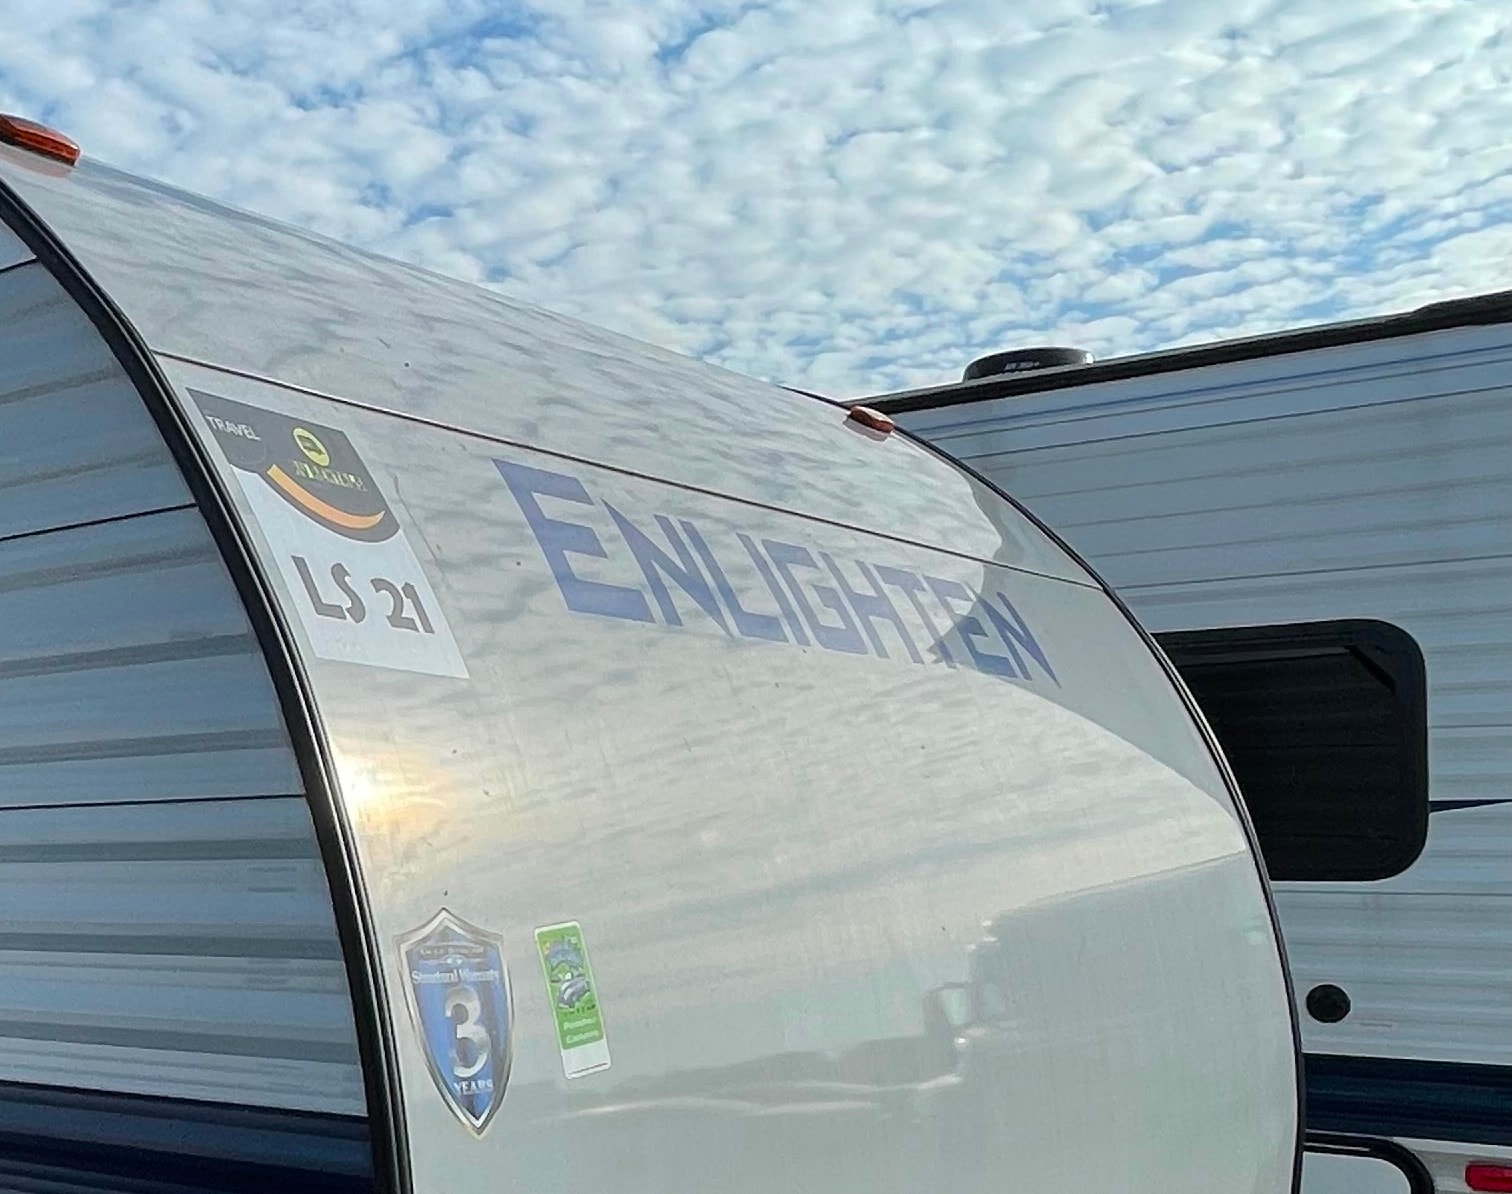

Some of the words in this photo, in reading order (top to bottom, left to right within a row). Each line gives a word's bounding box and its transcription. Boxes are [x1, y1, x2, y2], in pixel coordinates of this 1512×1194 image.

[205, 415, 261, 442] TRAVEL
[291, 554, 365, 624] LS
[370, 577, 435, 635] 21
[491, 457, 1062, 689] ENLIGHTEN
[445, 985, 489, 1078] 3
[452, 1078, 494, 1097] YEARS
